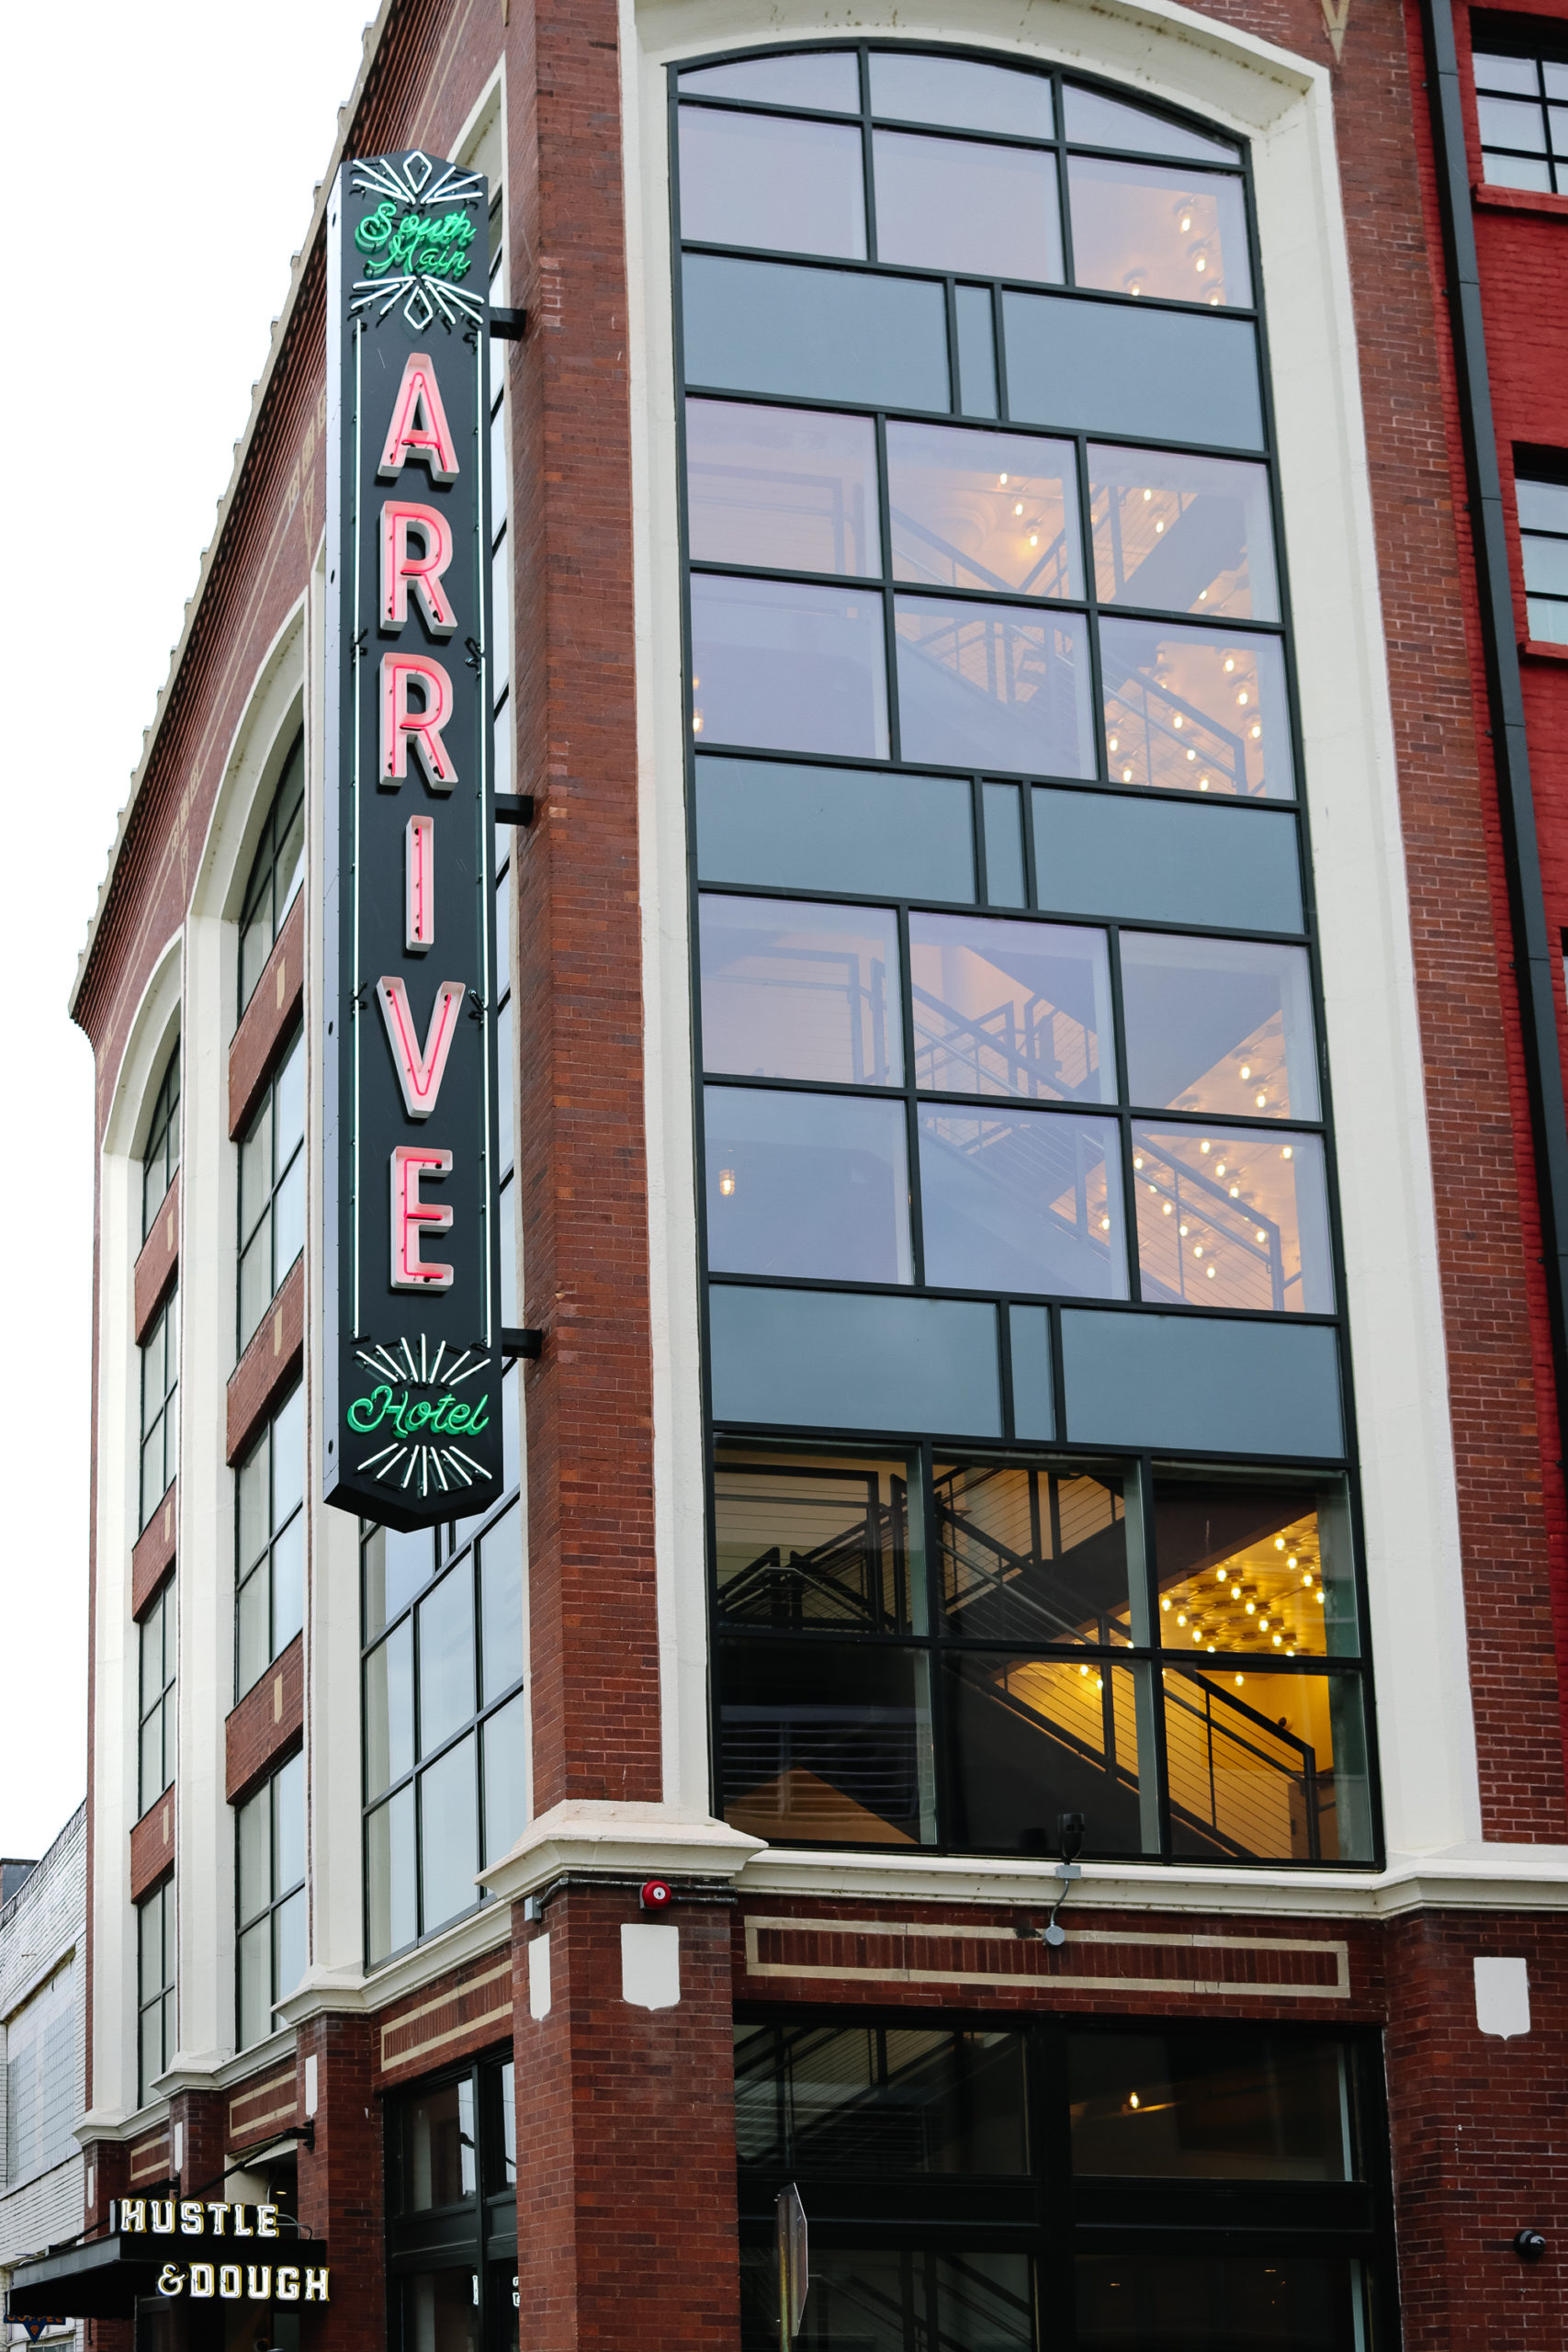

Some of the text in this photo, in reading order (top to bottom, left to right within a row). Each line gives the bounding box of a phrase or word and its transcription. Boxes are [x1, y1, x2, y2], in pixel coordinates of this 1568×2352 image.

[355, 201, 477, 252] South
[364, 235, 471, 277] Main
[376, 352, 467, 1292] ARRIVE
[347, 1385, 490, 1439] Hotel
[118, 2198, 280, 2238] HUSTLE
